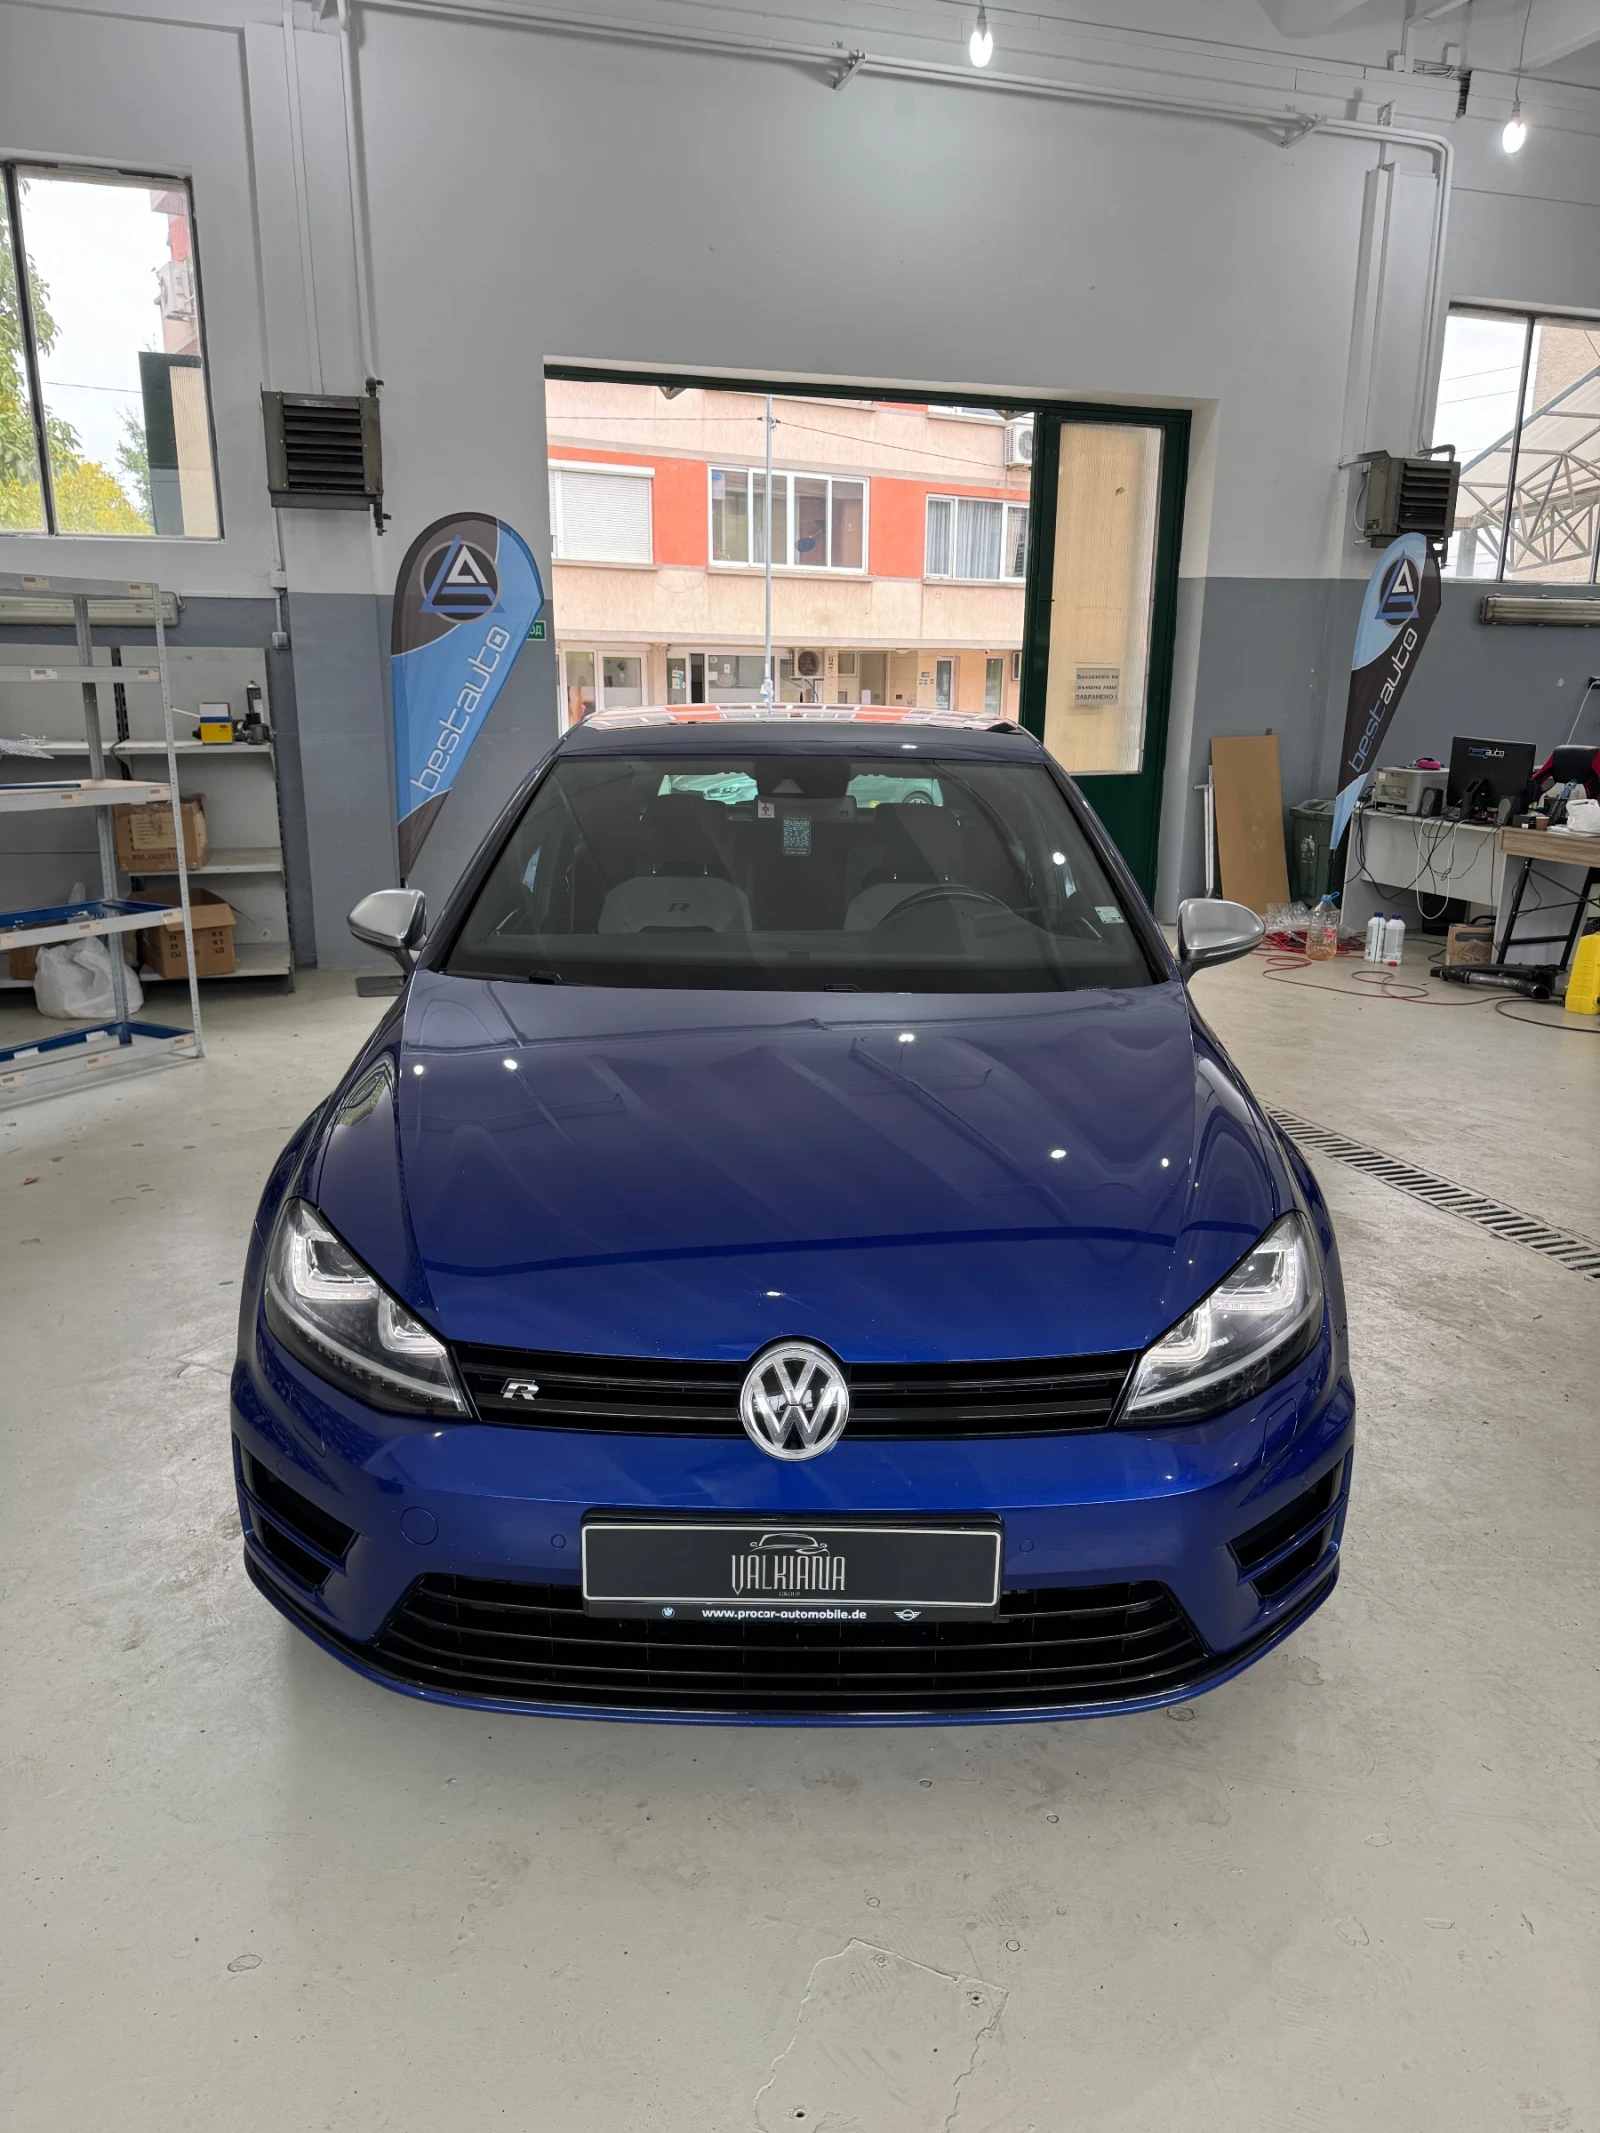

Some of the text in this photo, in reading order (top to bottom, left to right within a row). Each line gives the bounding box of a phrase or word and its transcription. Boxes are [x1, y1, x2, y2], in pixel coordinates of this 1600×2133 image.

[410, 626, 510, 793] bestauto
[1348, 627, 1418, 773] bestauto
[500, 1377, 539, 1400] R
[731, 1554, 846, 1596] VALKIANA
[702, 1609, 867, 1620] www.procar-automobile.de
